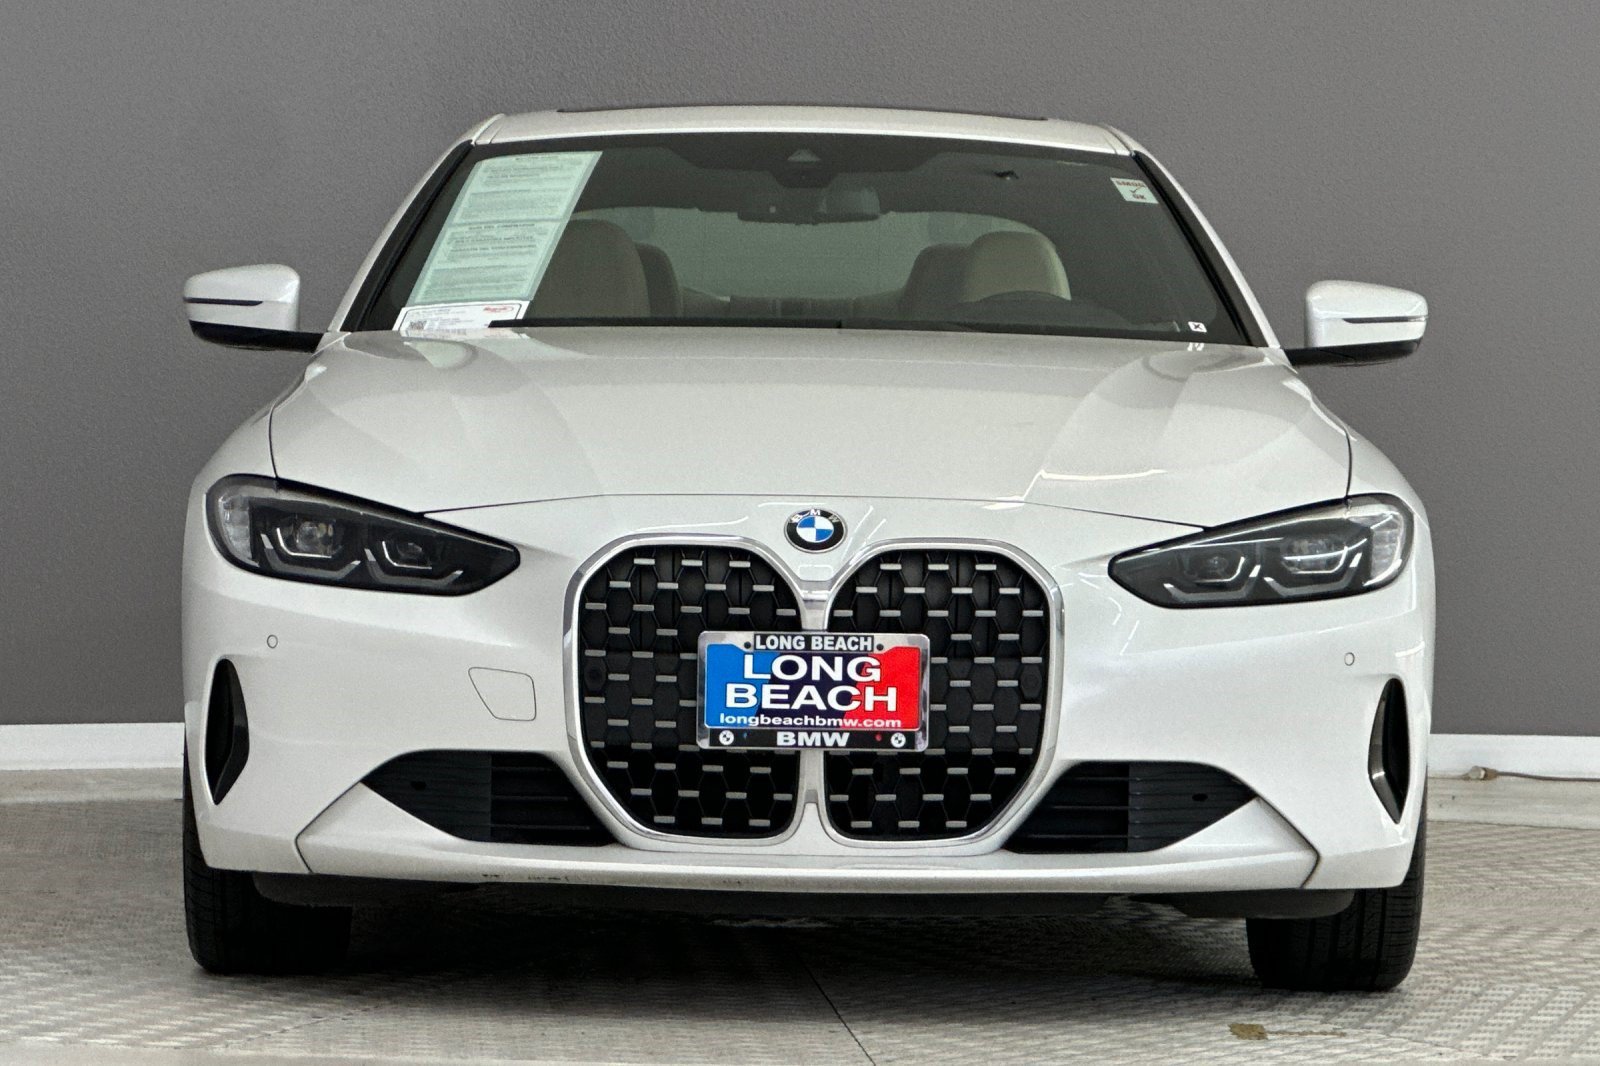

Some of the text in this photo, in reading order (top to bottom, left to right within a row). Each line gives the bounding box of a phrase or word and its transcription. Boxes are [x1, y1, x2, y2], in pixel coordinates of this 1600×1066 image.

[755, 635, 872, 651] LONG BEACH
[743, 654, 881, 682] LONG
[725, 683, 897, 712] BEACH
[719, 713, 902, 728] longbeachbmw.com
[776, 731, 850, 747] BMW
